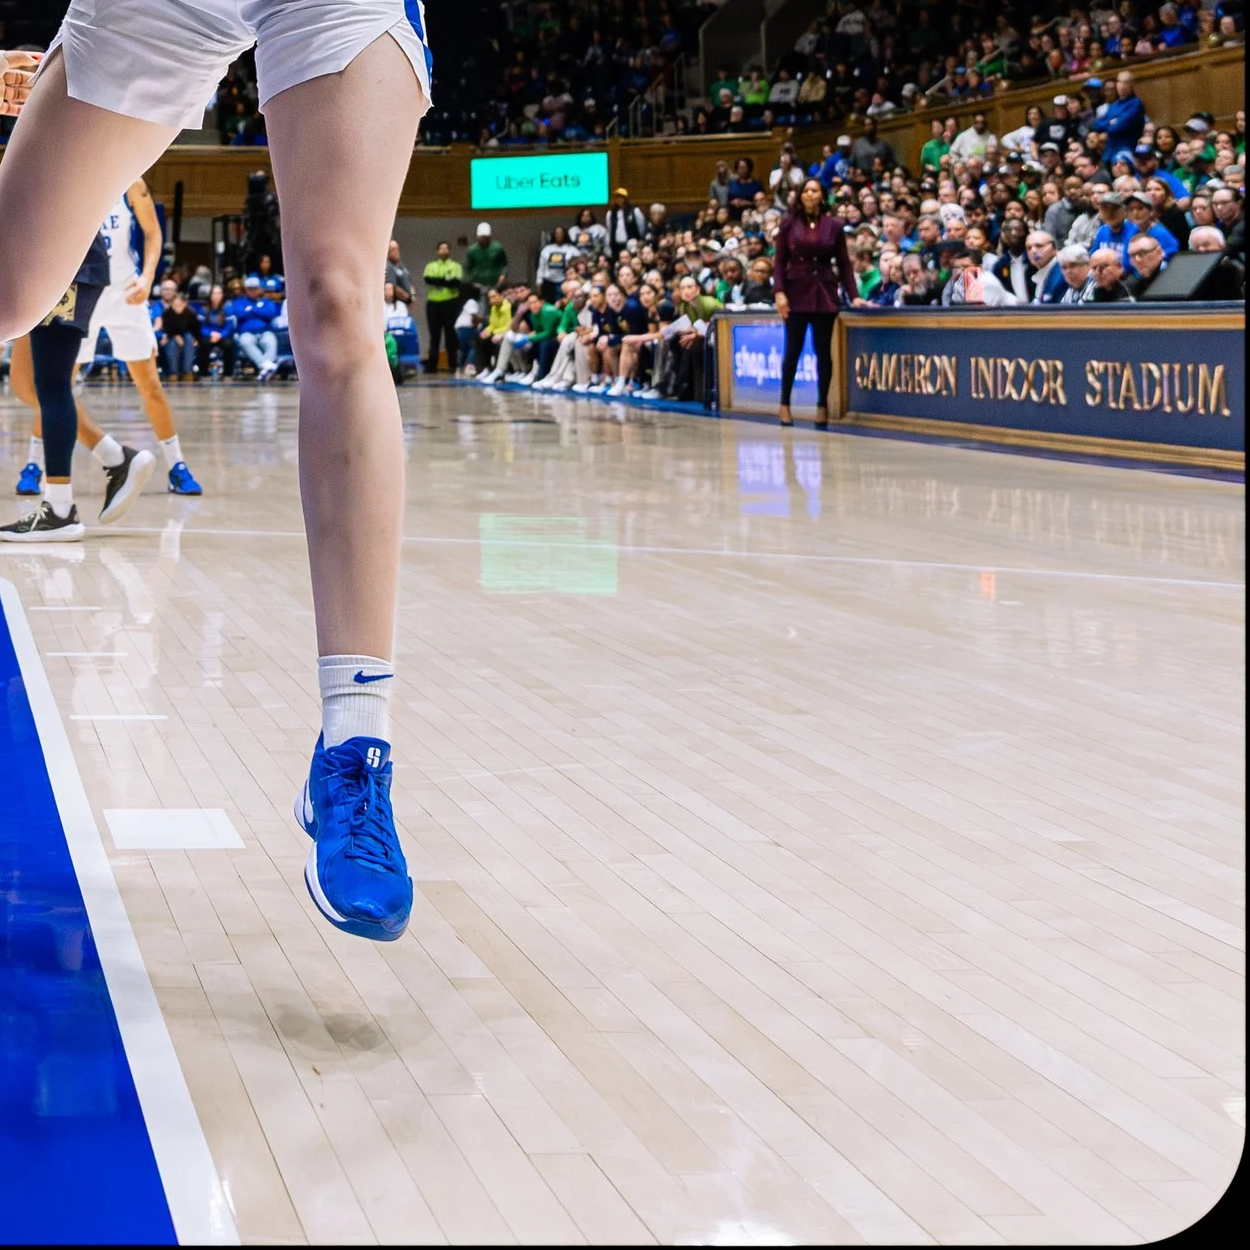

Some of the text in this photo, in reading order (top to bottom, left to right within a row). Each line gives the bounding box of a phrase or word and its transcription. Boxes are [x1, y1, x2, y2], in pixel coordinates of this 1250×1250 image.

[495, 172, 581, 190] Uber Eats
[854, 352, 1231, 418] CAMERON INDOOR STADIUM
